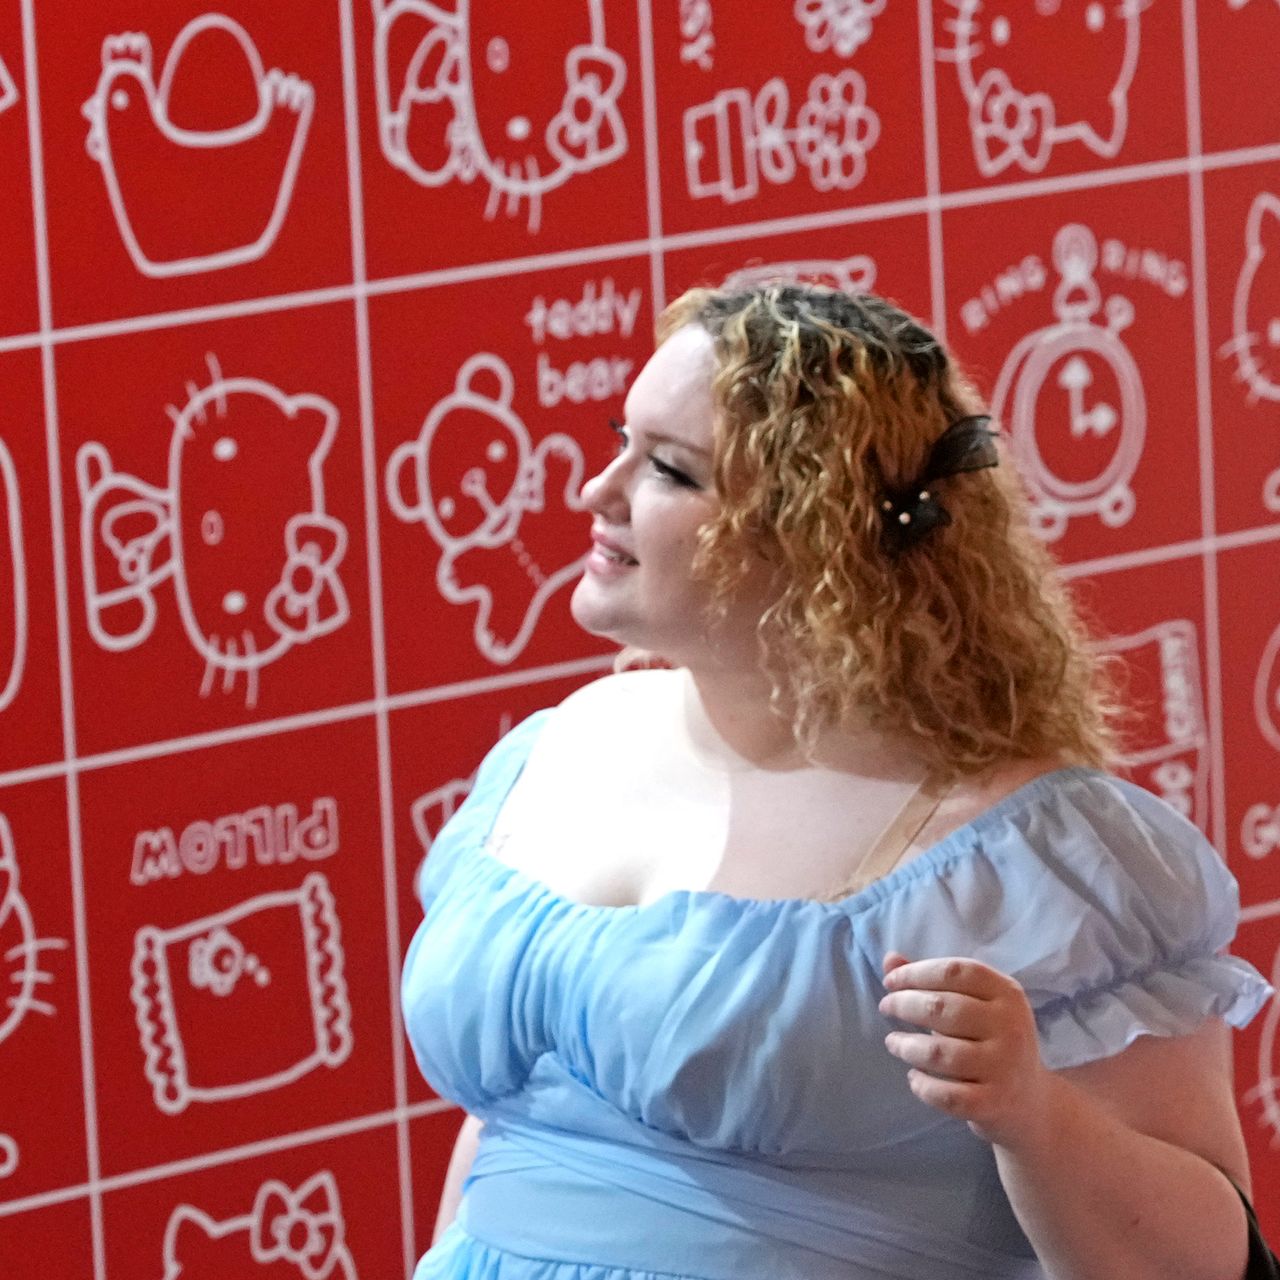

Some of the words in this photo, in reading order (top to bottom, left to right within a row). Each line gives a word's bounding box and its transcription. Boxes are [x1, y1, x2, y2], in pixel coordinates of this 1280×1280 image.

[525, 276, 643, 345] teddy
[960, 255, 1047, 337] RING
[1102, 238, 1189, 297] RING
[537, 352, 634, 408] bear
[129, 797, 340, 885] PILLOW
